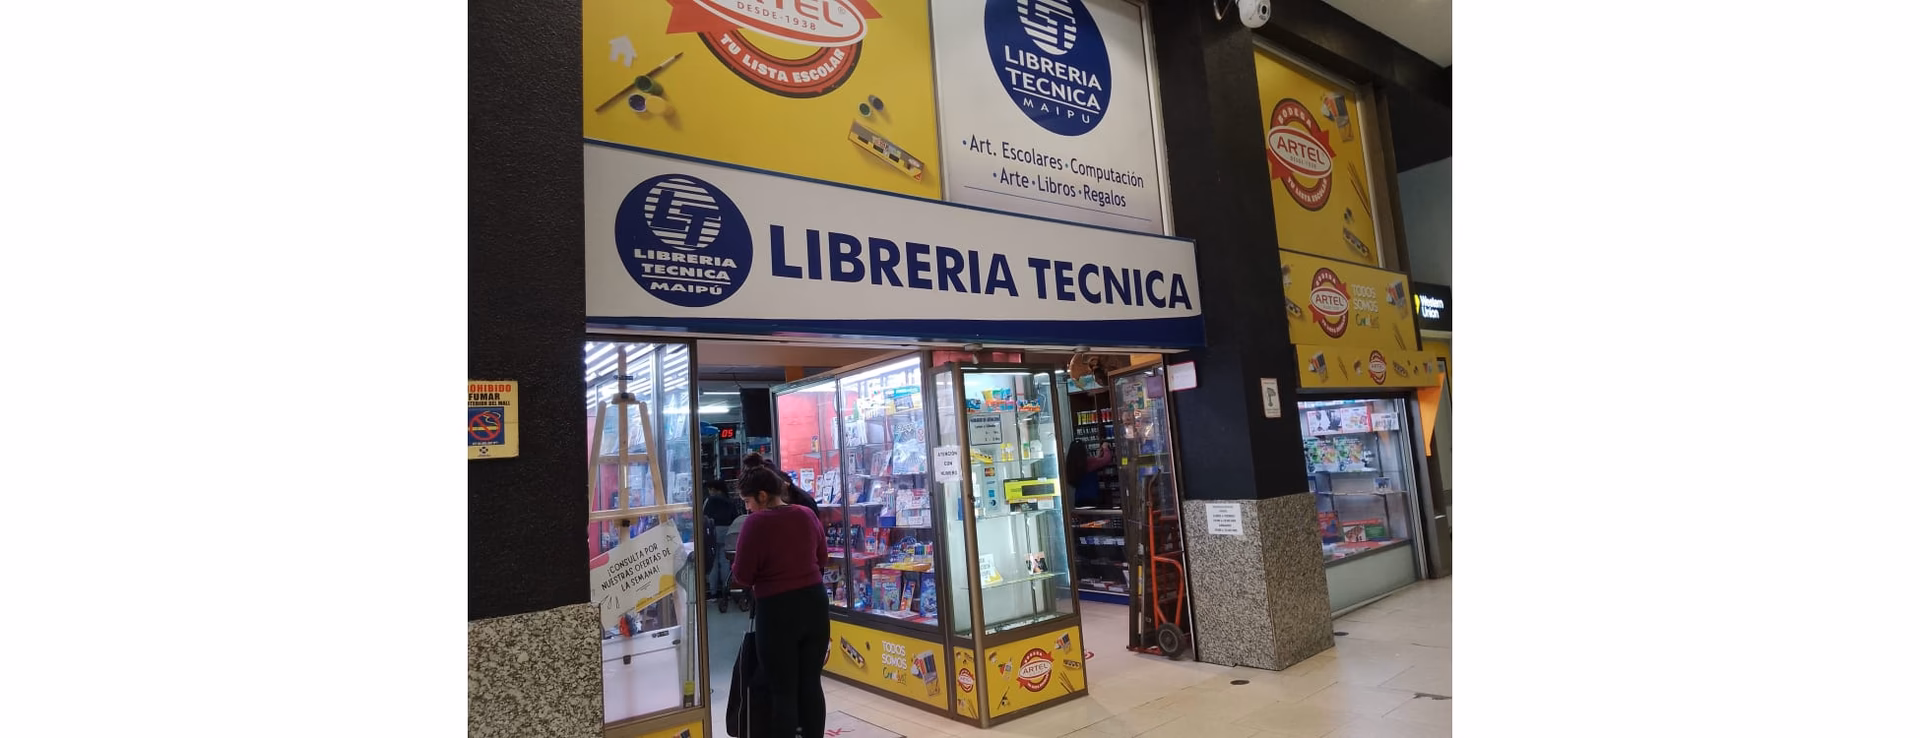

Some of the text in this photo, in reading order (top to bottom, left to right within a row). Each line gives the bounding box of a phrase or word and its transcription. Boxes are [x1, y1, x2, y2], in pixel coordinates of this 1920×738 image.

[720, 33, 846, 84] TU LISTA ESCOLAR
[1004, 45, 1102, 91] LIBRERIA
[1005, 67, 1101, 110] TECNICA
[1023, 97, 1090, 123] MAIPU
[969, 134, 1144, 188] Art. Escolares Computación
[1277, 136, 1325, 165] ARTEL
[1000, 167, 1127, 207] Arte Libros Regalos
[633, 248, 737, 269] LIBRERIA
[641, 263, 731, 280] TECNICA
[769, 224, 1194, 311] LIBRERIA TECNICA
[650, 281, 723, 295] MAIPÚ
[1315, 294, 1345, 307] ARTEL
[468, 384, 512, 392] OHIBIDO
[468, 393, 500, 401] FUMAR
[601, 547, 672, 590] NUESTRAS OFERTAS DE
[607, 542, 658, 577] ¡CONSULTA POR
[621, 565, 661, 592] LA SEMANA!
[881, 653, 907, 670] SOMOS
[882, 640, 906, 657] TODOS
[1022, 663, 1049, 675] ARTEL
